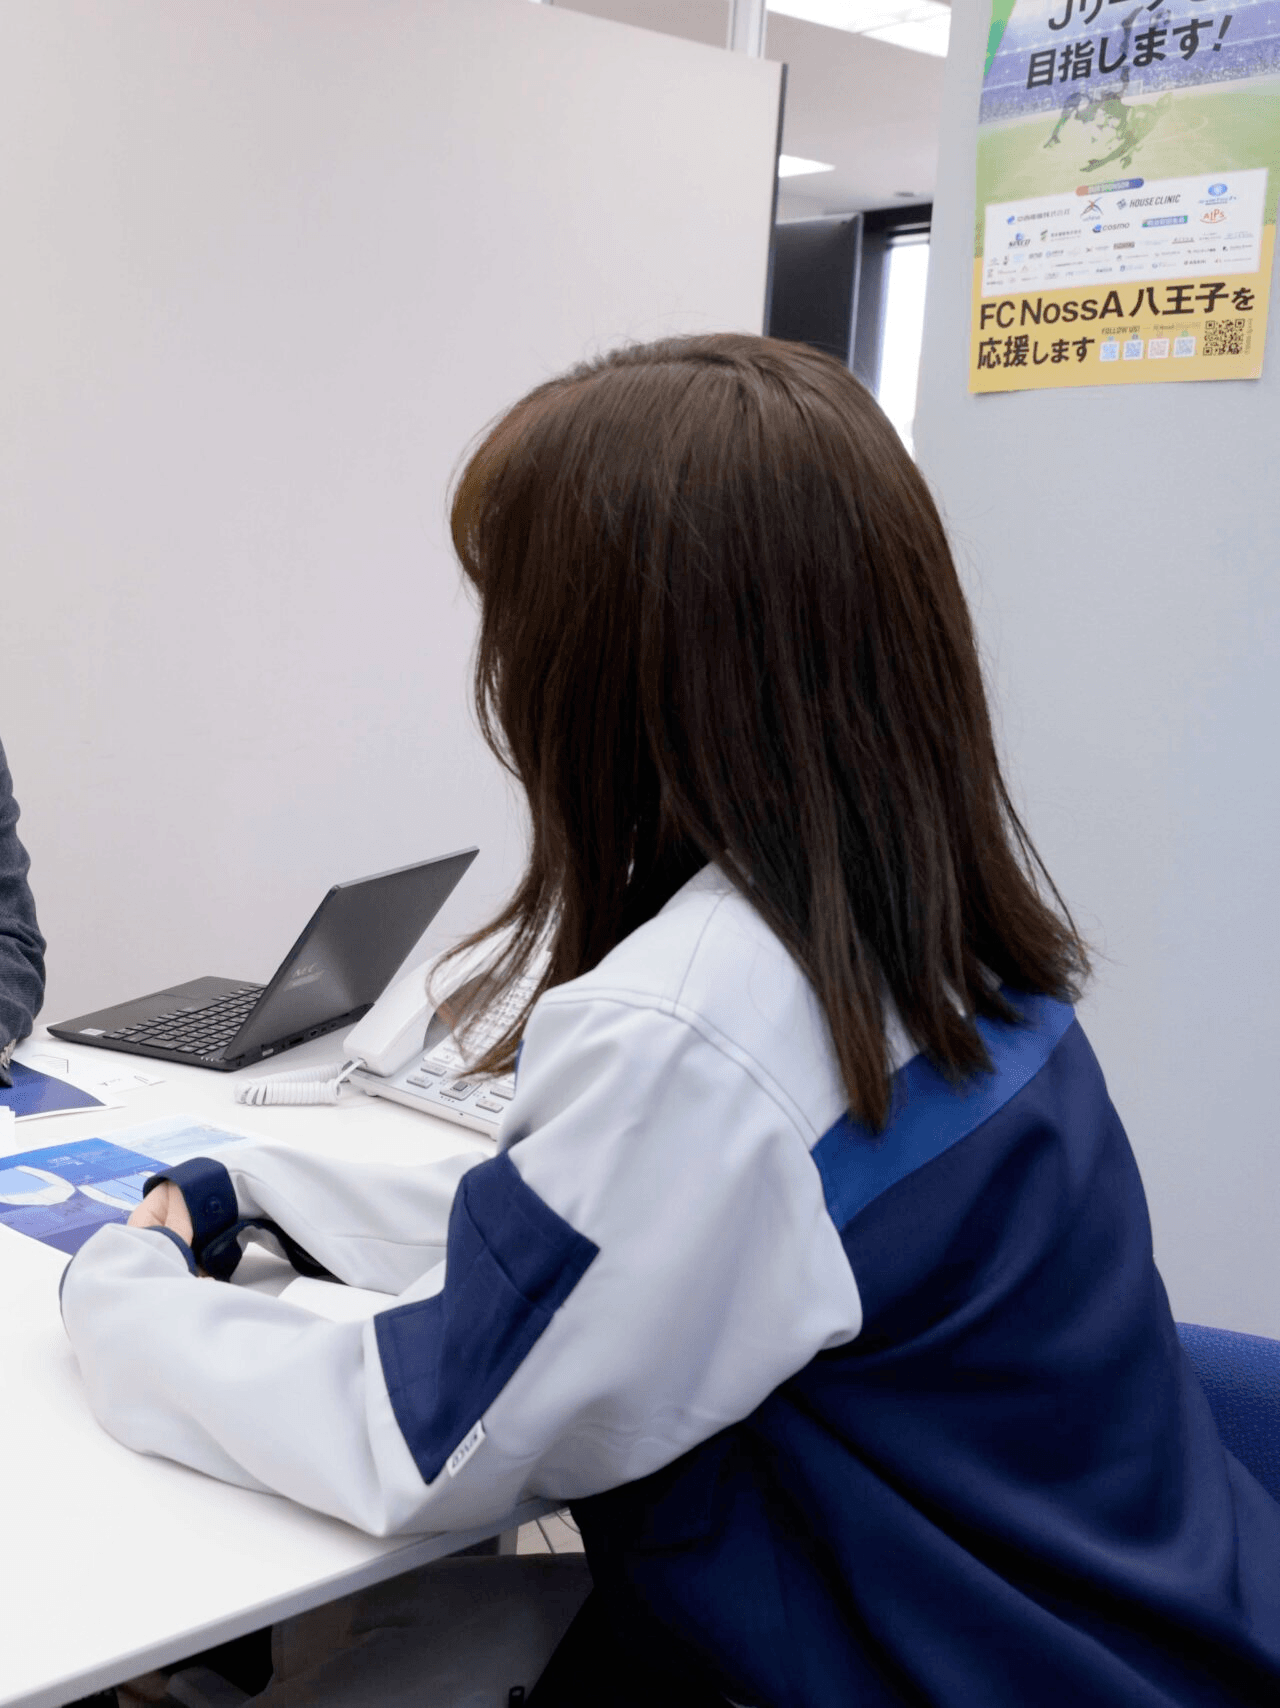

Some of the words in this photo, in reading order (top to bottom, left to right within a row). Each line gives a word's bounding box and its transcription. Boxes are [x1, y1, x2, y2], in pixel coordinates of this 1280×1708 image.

[1026, 15, 1233, 90] 目指します!
[1129, 197, 1154, 208] HOUSE
[1154, 194, 1181, 205] CLINIC
[980, 300, 1015, 330] FC
[1129, 282, 1255, 317] 八王子を
[977, 334, 1095, 370] 応援します
